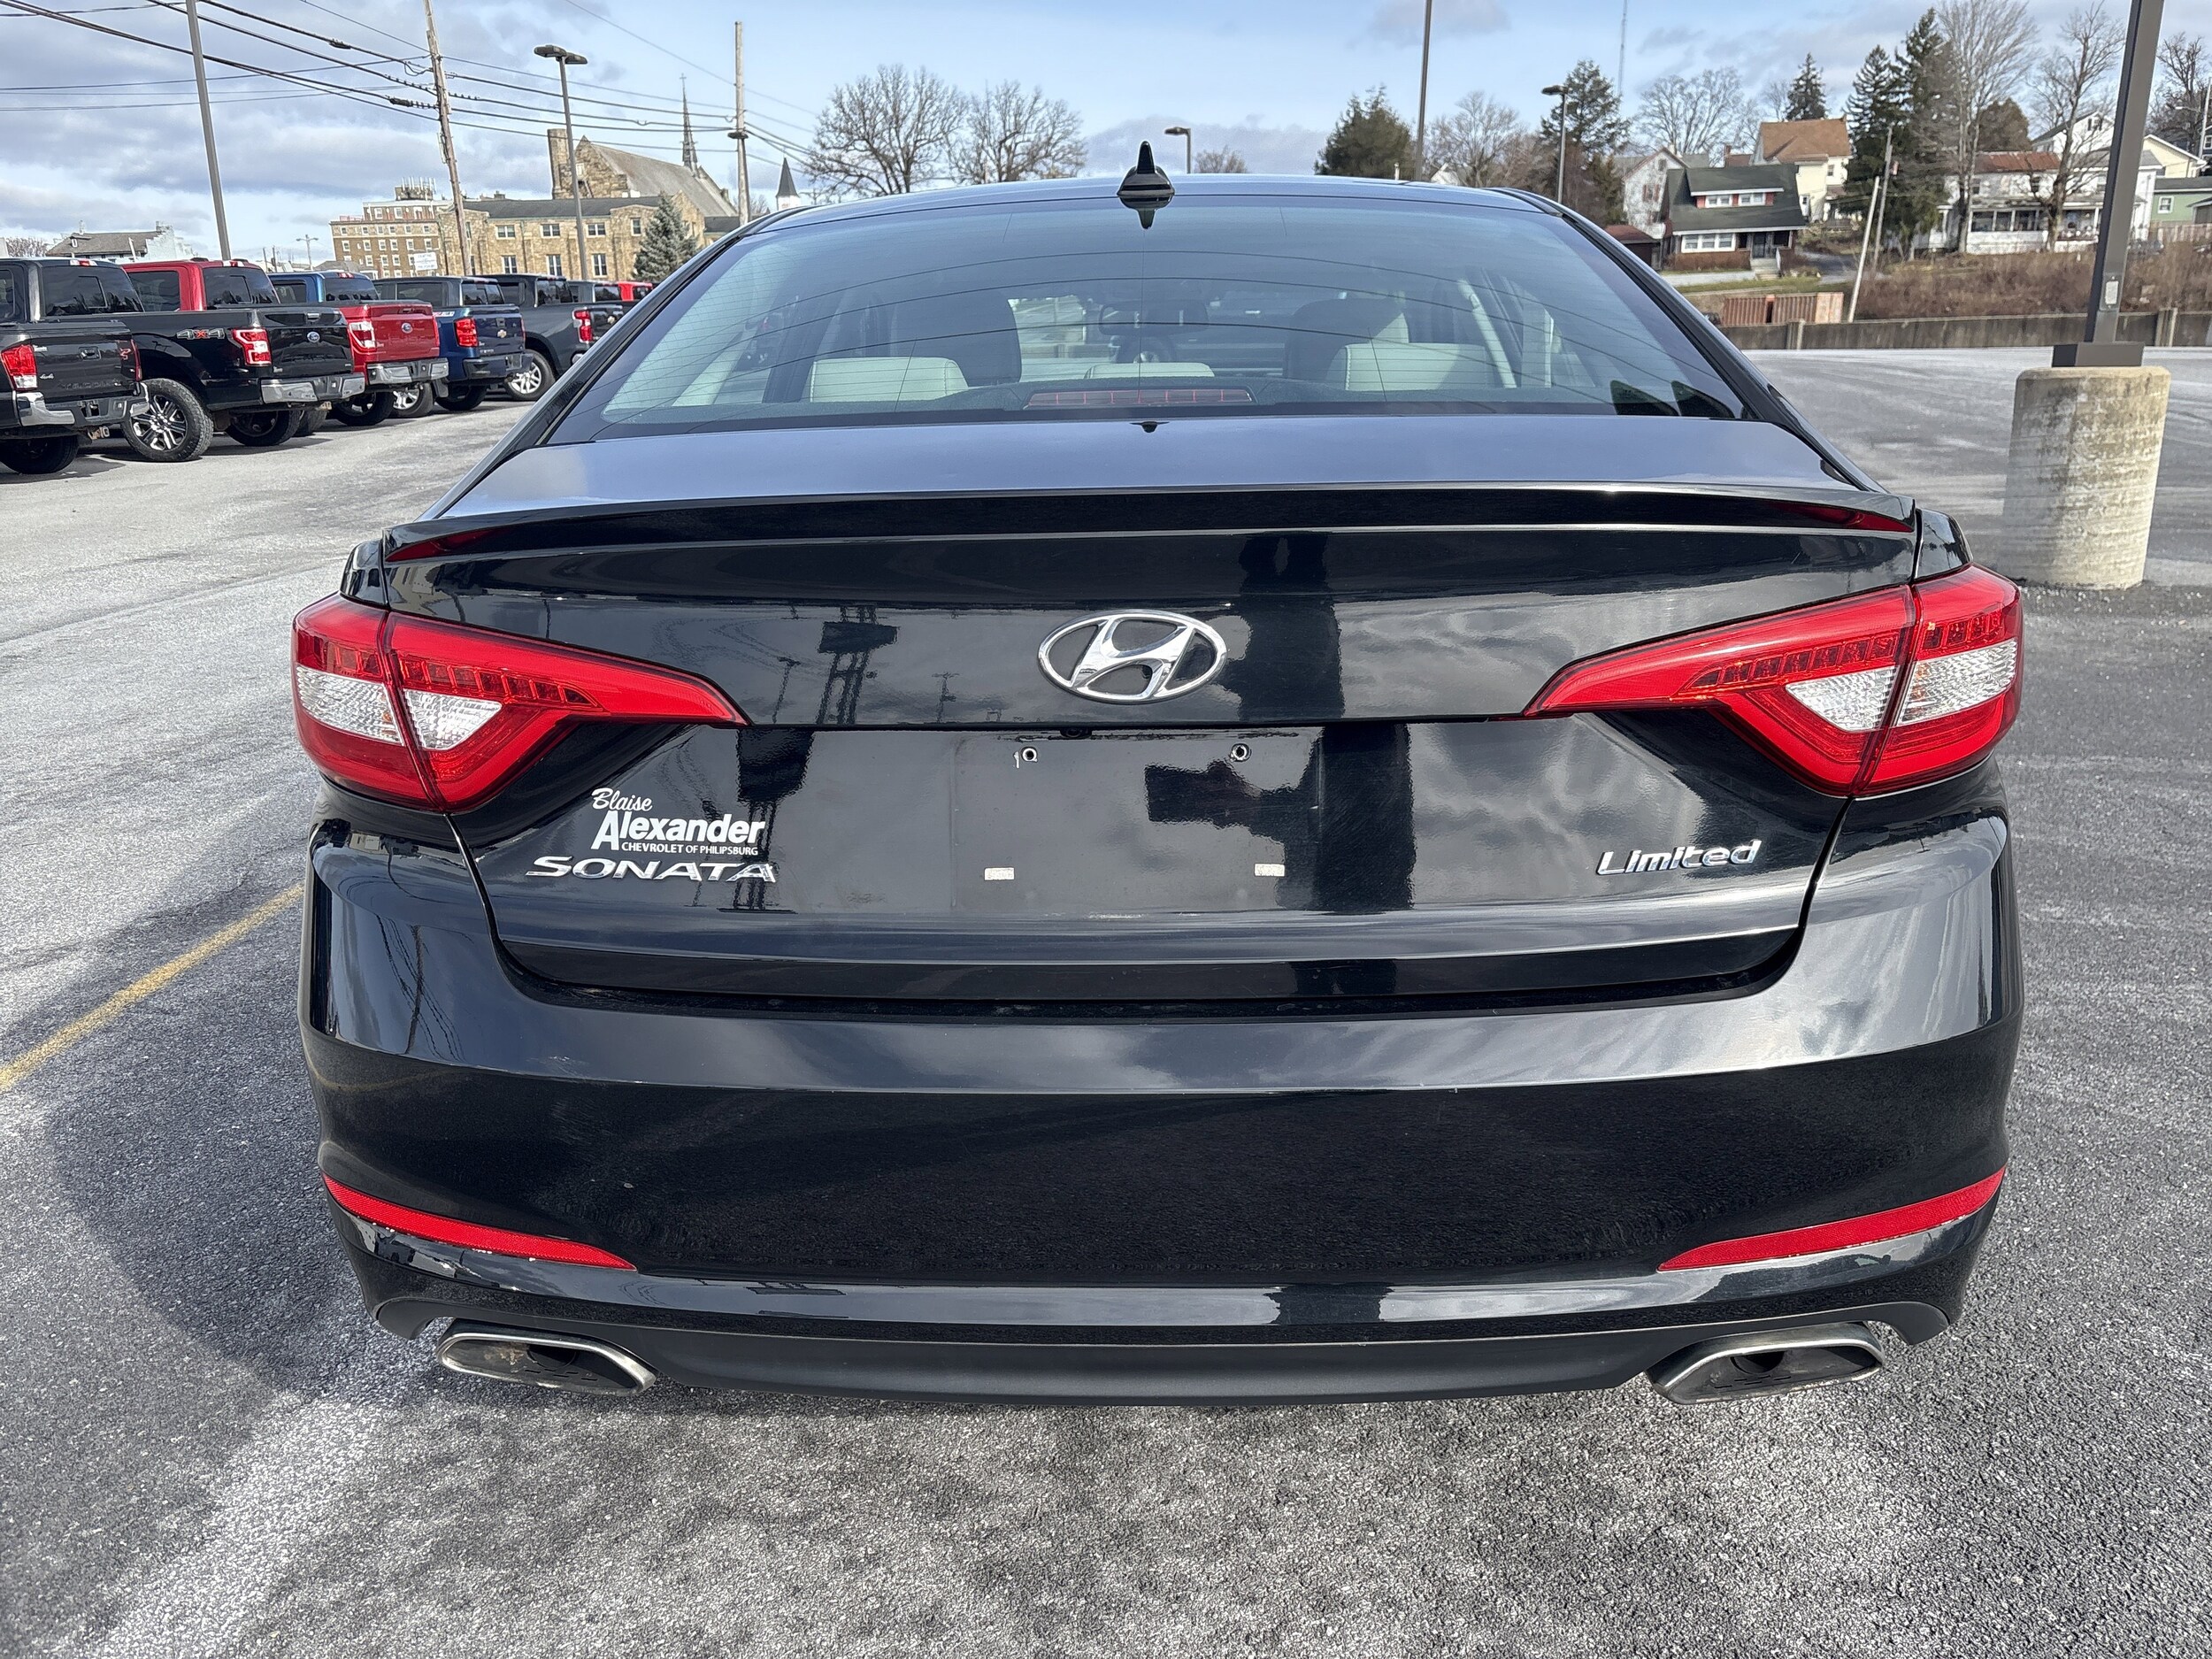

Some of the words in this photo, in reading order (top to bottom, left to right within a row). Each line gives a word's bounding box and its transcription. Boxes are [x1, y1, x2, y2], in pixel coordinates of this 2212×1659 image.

[591, 787, 653, 811] Blaise
[590, 810, 765, 850] Alexander
[621, 841, 684, 854] CHEVROLET
[685, 845, 699, 854] OF
[699, 845, 758, 856] PHILIPSBURG
[1596, 839, 1762, 875] Limited
[525, 856, 776, 883] SONATA
